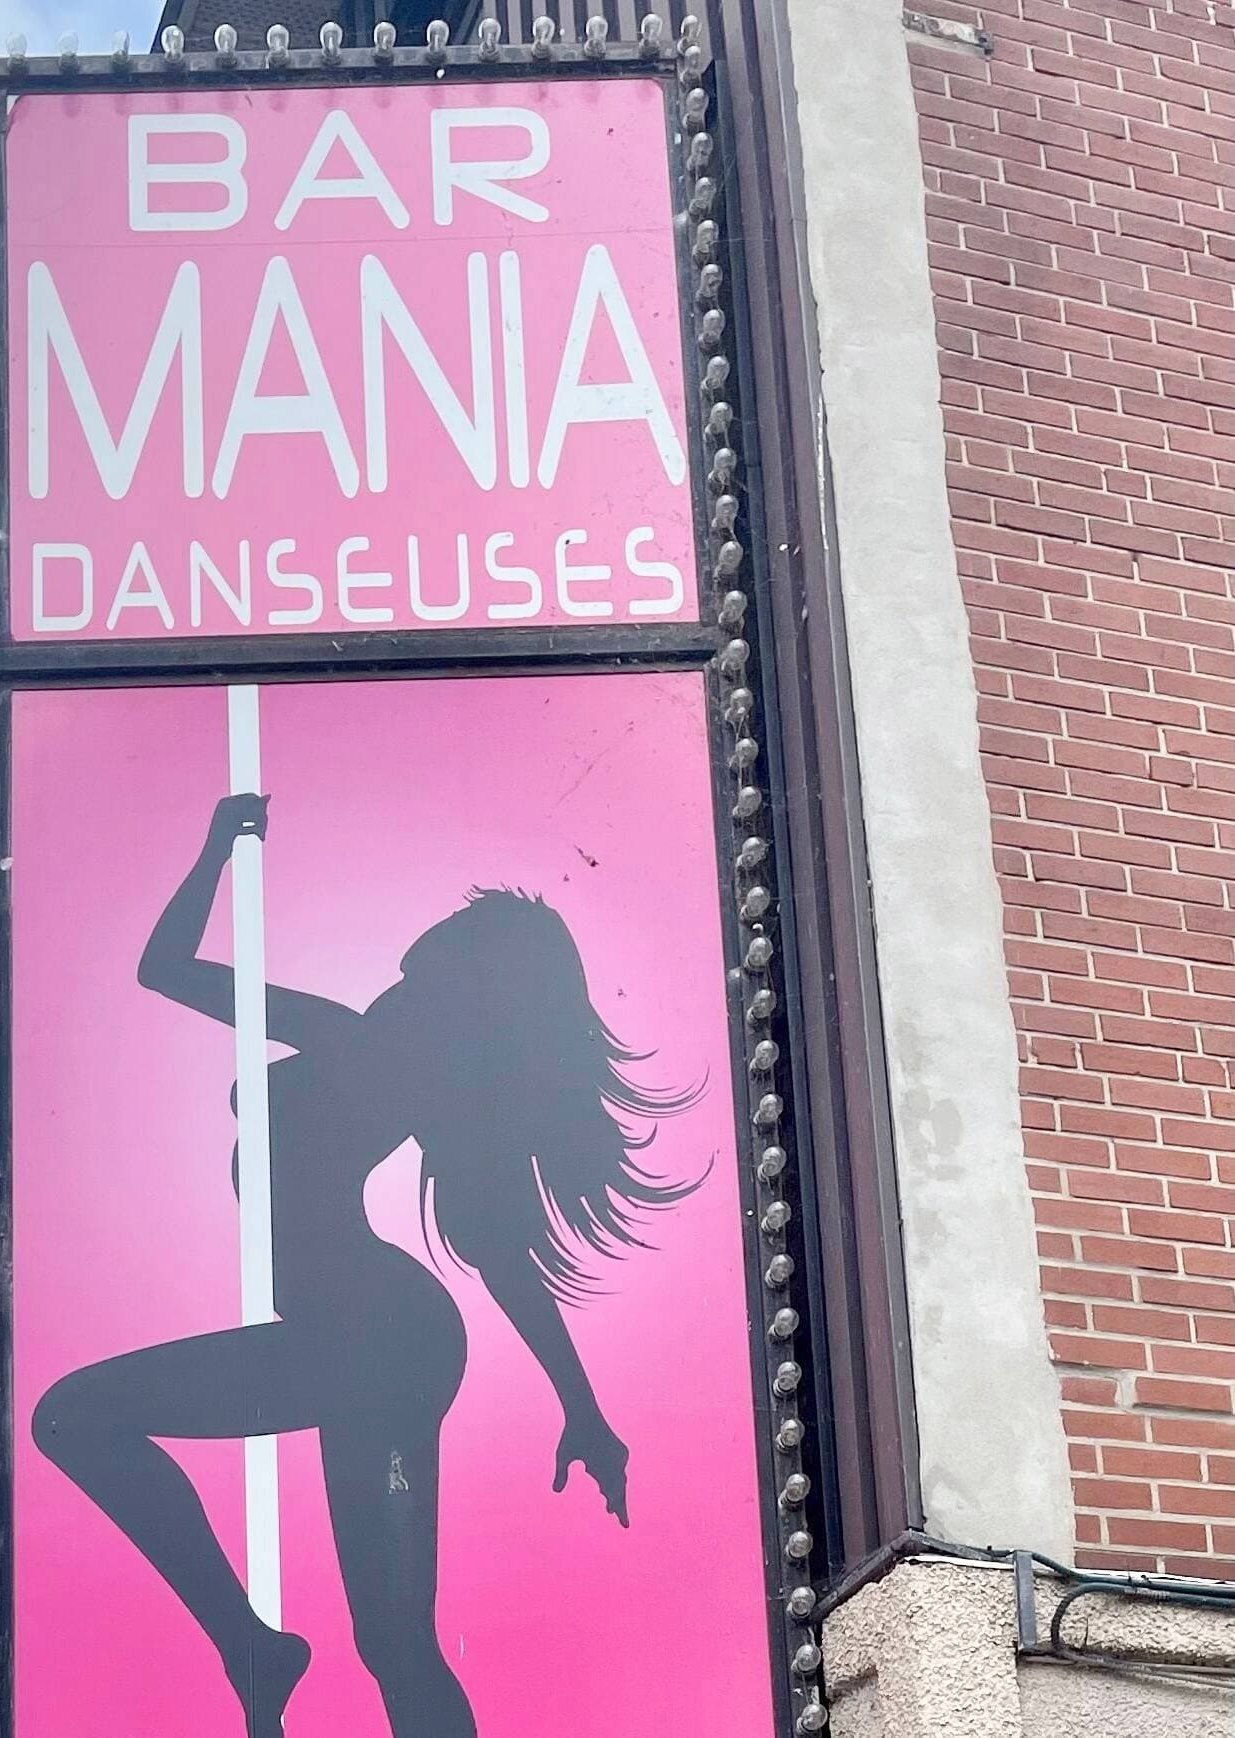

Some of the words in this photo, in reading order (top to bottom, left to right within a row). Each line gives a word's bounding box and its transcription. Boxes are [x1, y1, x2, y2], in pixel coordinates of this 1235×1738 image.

[128, 108, 551, 232] BAR
[26, 244, 685, 500] MANIA
[32, 527, 685, 632] DANSEUSES
